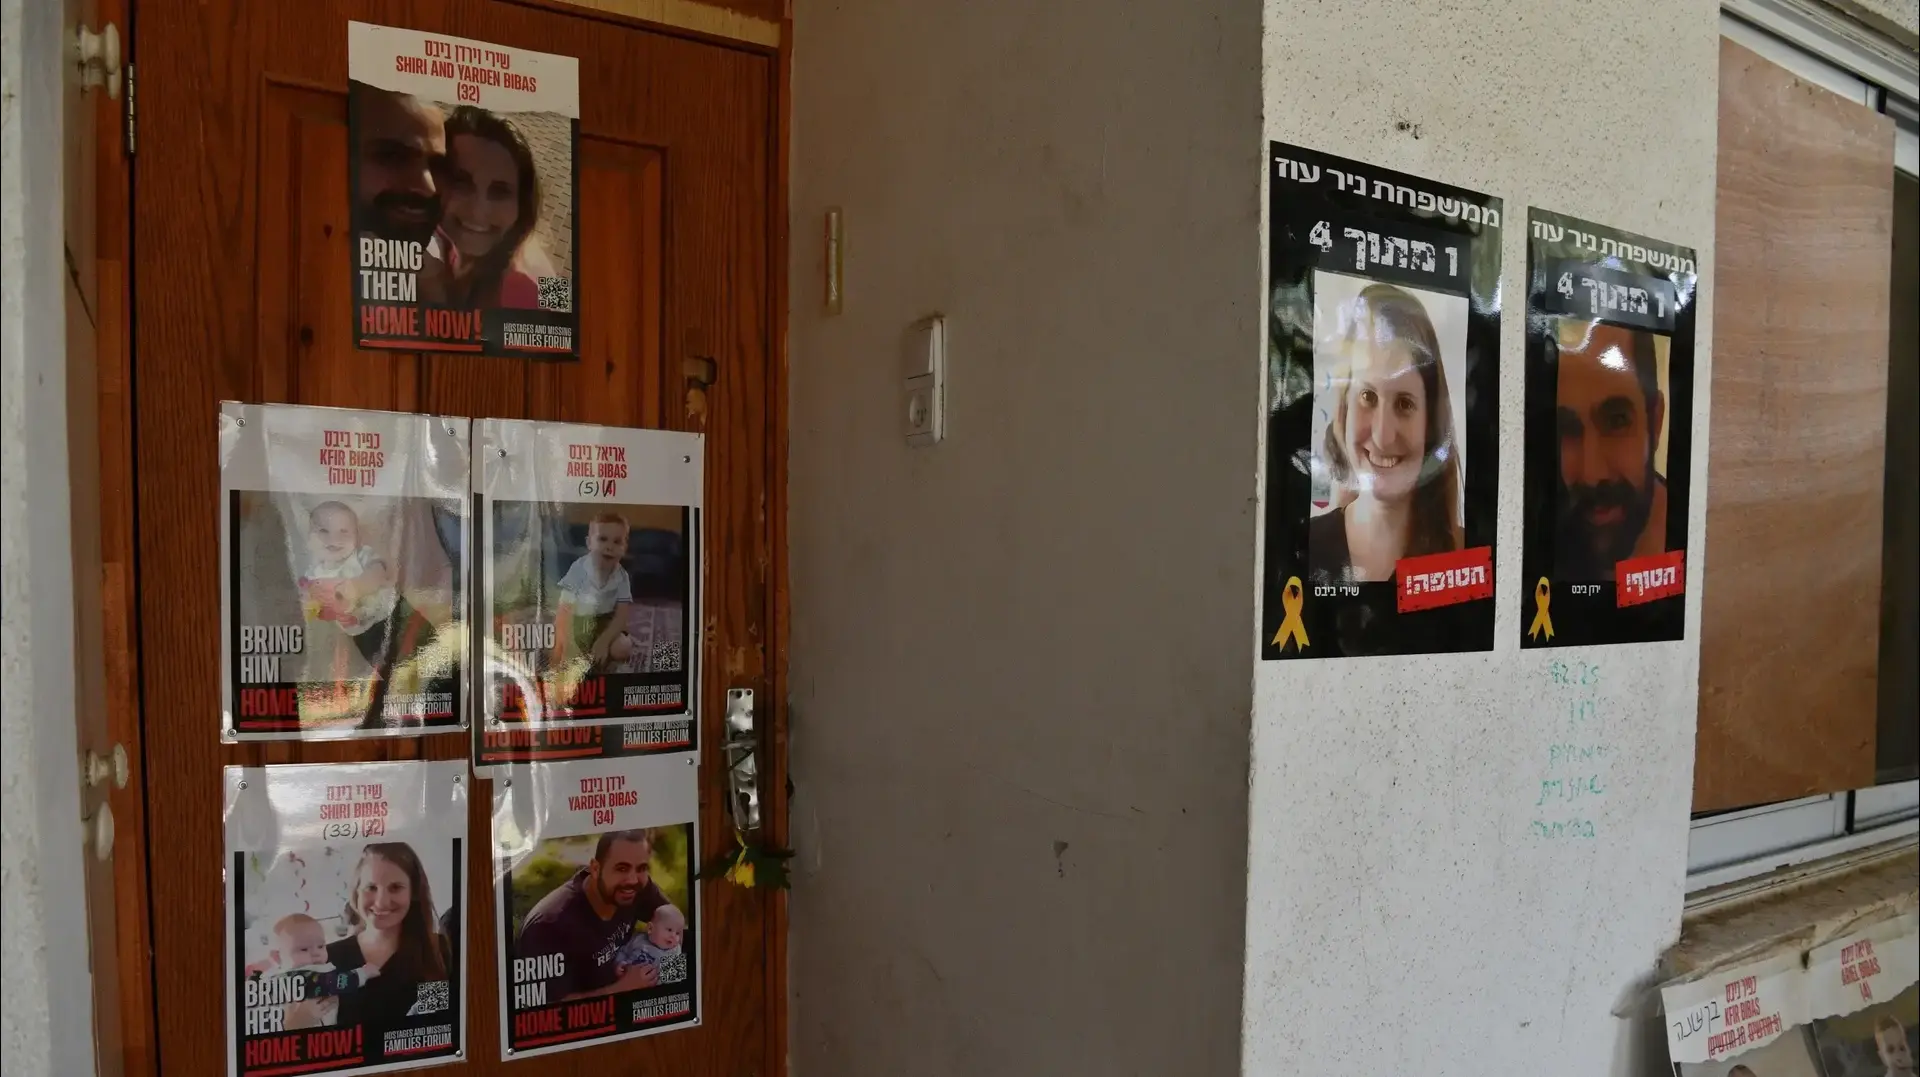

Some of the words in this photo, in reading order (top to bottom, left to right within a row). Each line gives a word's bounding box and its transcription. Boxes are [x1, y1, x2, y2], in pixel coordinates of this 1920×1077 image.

[424, 40, 451, 59] ביבס
[455, 45, 482, 64] וירדן
[485, 50, 511, 69] שירי
[396, 55, 427, 75] SHIRI
[431, 60, 454, 78] AND
[458, 64, 501, 87] YARDEN
[504, 73, 537, 93] BIBAS
[457, 82, 480, 103] (32)
[1275, 157, 1320, 183] עוז
[1326, 168, 1367, 196] ניר
[1371, 180, 1500, 228] ממשפחת
[1309, 220, 1333, 253] 4
[1531, 220, 1564, 243] עוז
[1568, 229, 1598, 252] ניר
[359, 237, 423, 270] BRING
[1344, 227, 1436, 273] מתוך
[1600, 237, 1695, 274] ממשפחת
[359, 270, 417, 302] THEM
[1557, 272, 1574, 300] 4
[1581, 277, 1649, 315] מתוך
[361, 305, 420, 336] HOME
[425, 308, 482, 340] NOW!
[503, 322, 534, 334] HOSTAGES
[534, 325, 547, 335] AND
[547, 326, 572, 336] MISSING
[503, 333, 543, 347] FAMILIES
[543, 336, 572, 350] FORUM
[324, 430, 351, 448] ביבס
[355, 432, 380, 449] כפיר
[320, 449, 345, 466] KFIR
[349, 450, 384, 468] BIBAS
[569, 444, 592, 460] ביבס
[594, 445, 626, 462] אריאל
[567, 461, 595, 478] ARIEL
[598, 463, 628, 479] BIBAS
[579, 480, 600, 497] (5)
[1314, 585, 1337, 597] ביבס
[1339, 586, 1360, 597] שירי
[241, 625, 304, 654] BRING
[501, 623, 556, 649] BRING
[240, 656, 281, 683] HIM
[624, 686, 650, 694] HOSTAGES
[650, 685, 661, 693] AND
[661, 684, 682, 693] MISSING
[624, 693, 656, 706] FAMILIES
[658, 692, 682, 704] FORUM
[240, 688, 298, 716] HOME
[424, 701, 452, 714] FORUM
[624, 722, 653, 732] HOSTAGES
[624, 731, 660, 745] FAMILIES
[662, 729, 689, 743] FORUM
[356, 784, 382, 800] שירי
[580, 778, 603, 794] ביבס
[605, 776, 625, 793] ירדן
[320, 803, 350, 819] SHIRI
[354, 801, 388, 818] BIBAS
[568, 793, 606, 811] YARDEN
[608, 791, 637, 807] BIBAS
[593, 809, 614, 826] (34)
[324, 822, 358, 840] (33)
[513, 952, 565, 983] BRING
[245, 975, 305, 1007] BRING
[514, 981, 547, 1009] HIM
[632, 998, 657, 1009] HOSTAGES
[657, 996, 668, 1005] AND
[632, 1005, 664, 1021] FAMILIES
[665, 1000, 689, 1015] FORUM
[1725, 1004, 1741, 1027] KFIR
[1740, 997, 1761, 1021] BIBAS
[245, 1006, 284, 1036] HER
[515, 1007, 562, 1037] HOME
[568, 995, 615, 1030] NOW!
[1673, 1007, 1703, 1041] שנה
[1704, 1001, 1720, 1033] בן
[384, 1029, 413, 1041] HOSTAGES
[413, 1027, 426, 1036] AND
[426, 1024, 452, 1035] MISSING
[384, 1037, 421, 1052] FAMILIES
[422, 1033, 452, 1047] FORUM
[245, 1034, 302, 1067] HOME
[306, 1024, 363, 1060] NOW!
